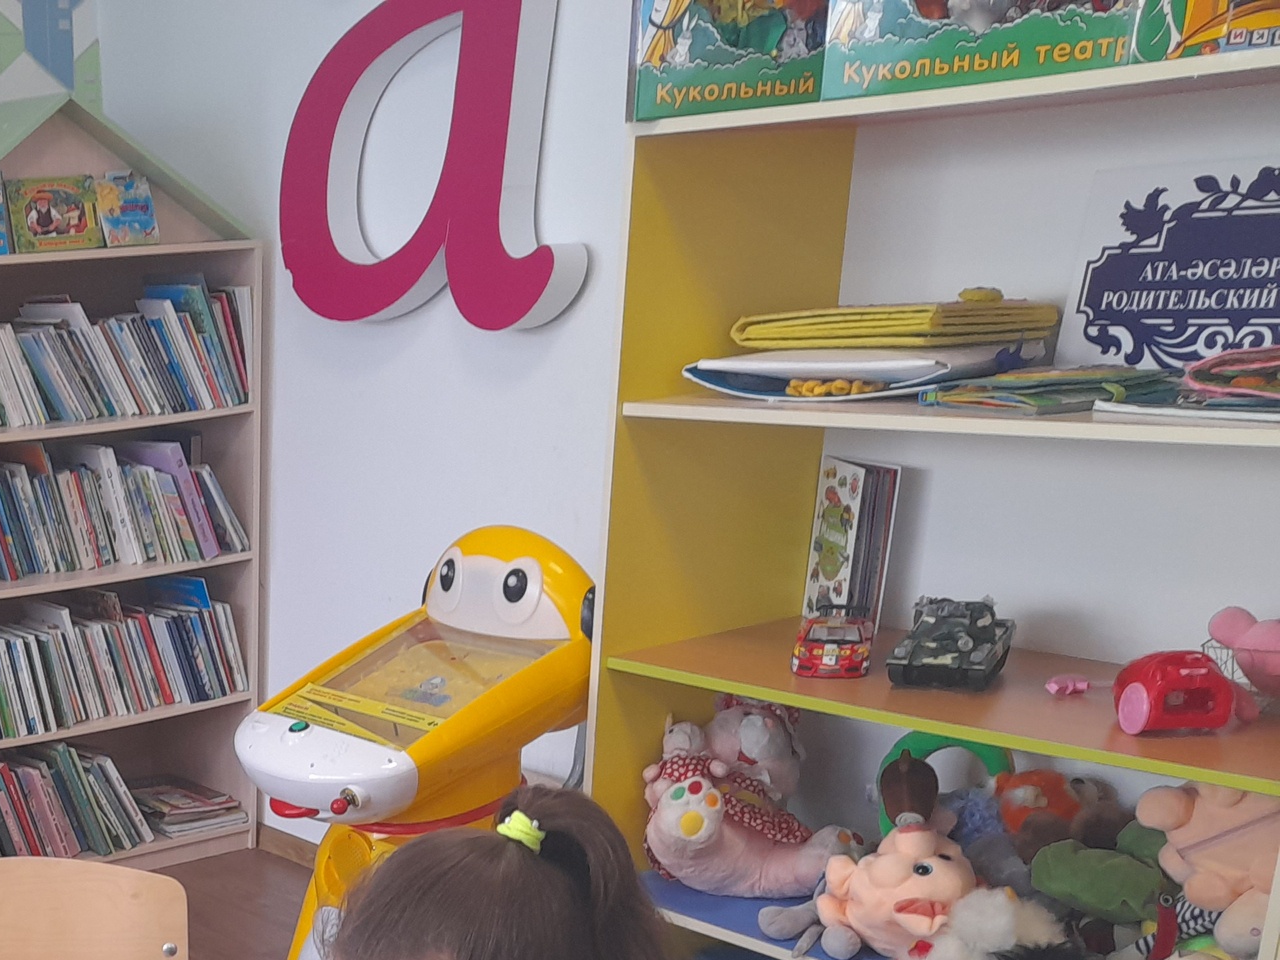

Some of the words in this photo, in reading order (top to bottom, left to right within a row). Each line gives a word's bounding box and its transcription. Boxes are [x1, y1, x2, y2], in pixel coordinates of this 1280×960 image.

[843, 40, 1021, 90] Кукольный
[655, 71, 815, 108] Кукольный
[1100, 282, 1279, 314] РОДИТЕЛЬСКИЙ
